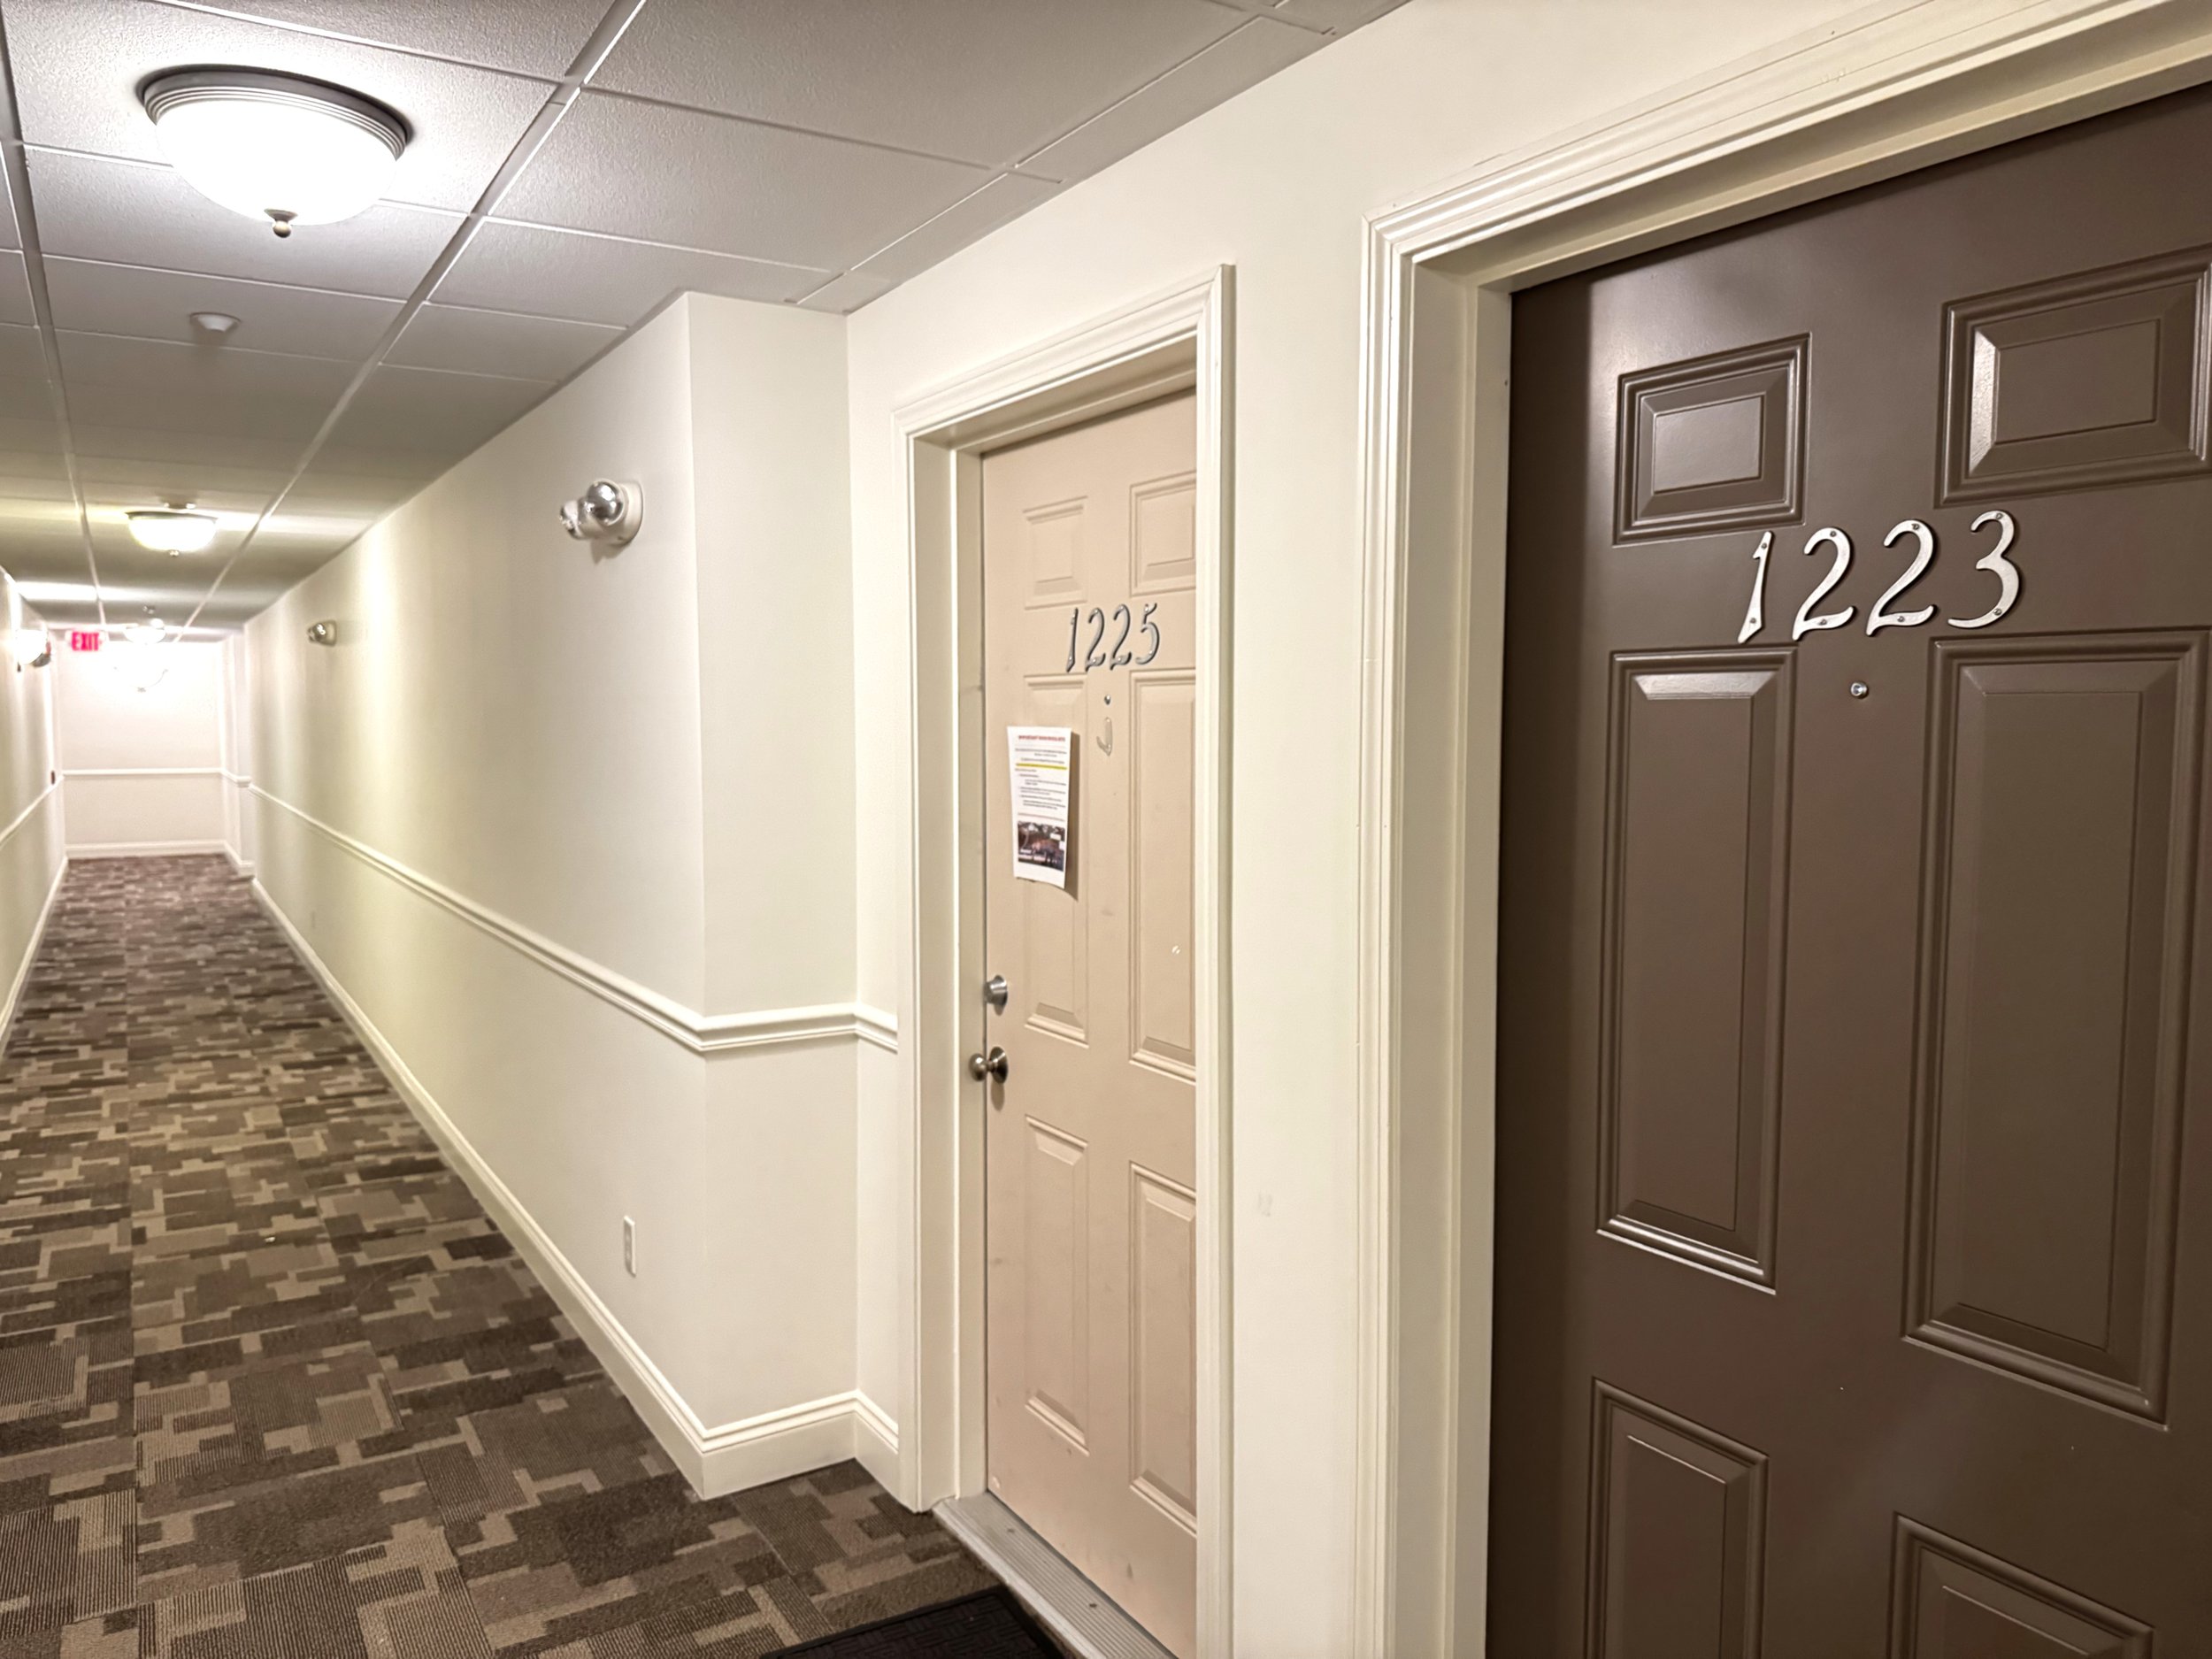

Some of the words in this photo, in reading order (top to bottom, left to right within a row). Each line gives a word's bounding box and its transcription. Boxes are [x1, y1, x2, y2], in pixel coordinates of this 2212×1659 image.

[1738, 510, 2020, 643] 1223
[72, 632, 99, 651] EXIT
[1066, 603, 1160, 672] 1225
